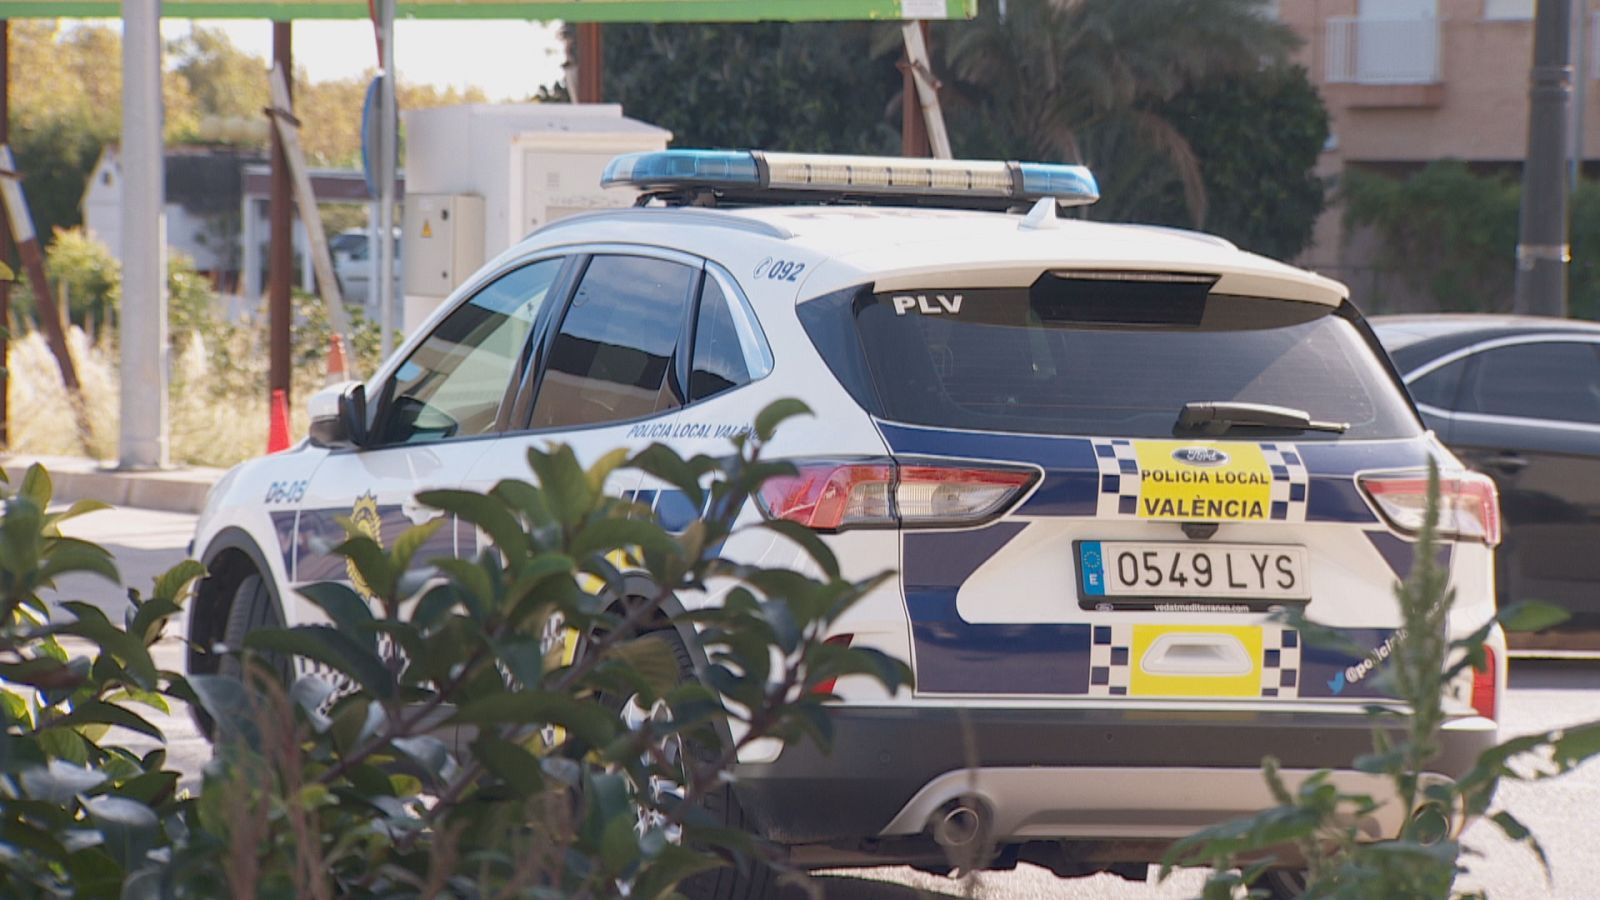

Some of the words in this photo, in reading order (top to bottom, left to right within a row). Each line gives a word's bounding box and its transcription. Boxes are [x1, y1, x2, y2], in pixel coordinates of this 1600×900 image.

[768, 260, 805, 282] 092
[893, 294, 962, 315] PLV
[627, 423, 671, 439] POLICIA
[673, 423, 712, 439] LOCAL
[1141, 470, 1209, 483] POLICIA
[1215, 471, 1269, 485] LOCAL
[264, 480, 307, 504] D6-05
[1144, 494, 1264, 518] VALÈNCIA
[1089, 573, 1099, 585] E
[1117, 551, 1213, 588] 0549
[1226, 552, 1296, 590] LYS
[1153, 603, 1249, 613] vedatmediterraneo.com
